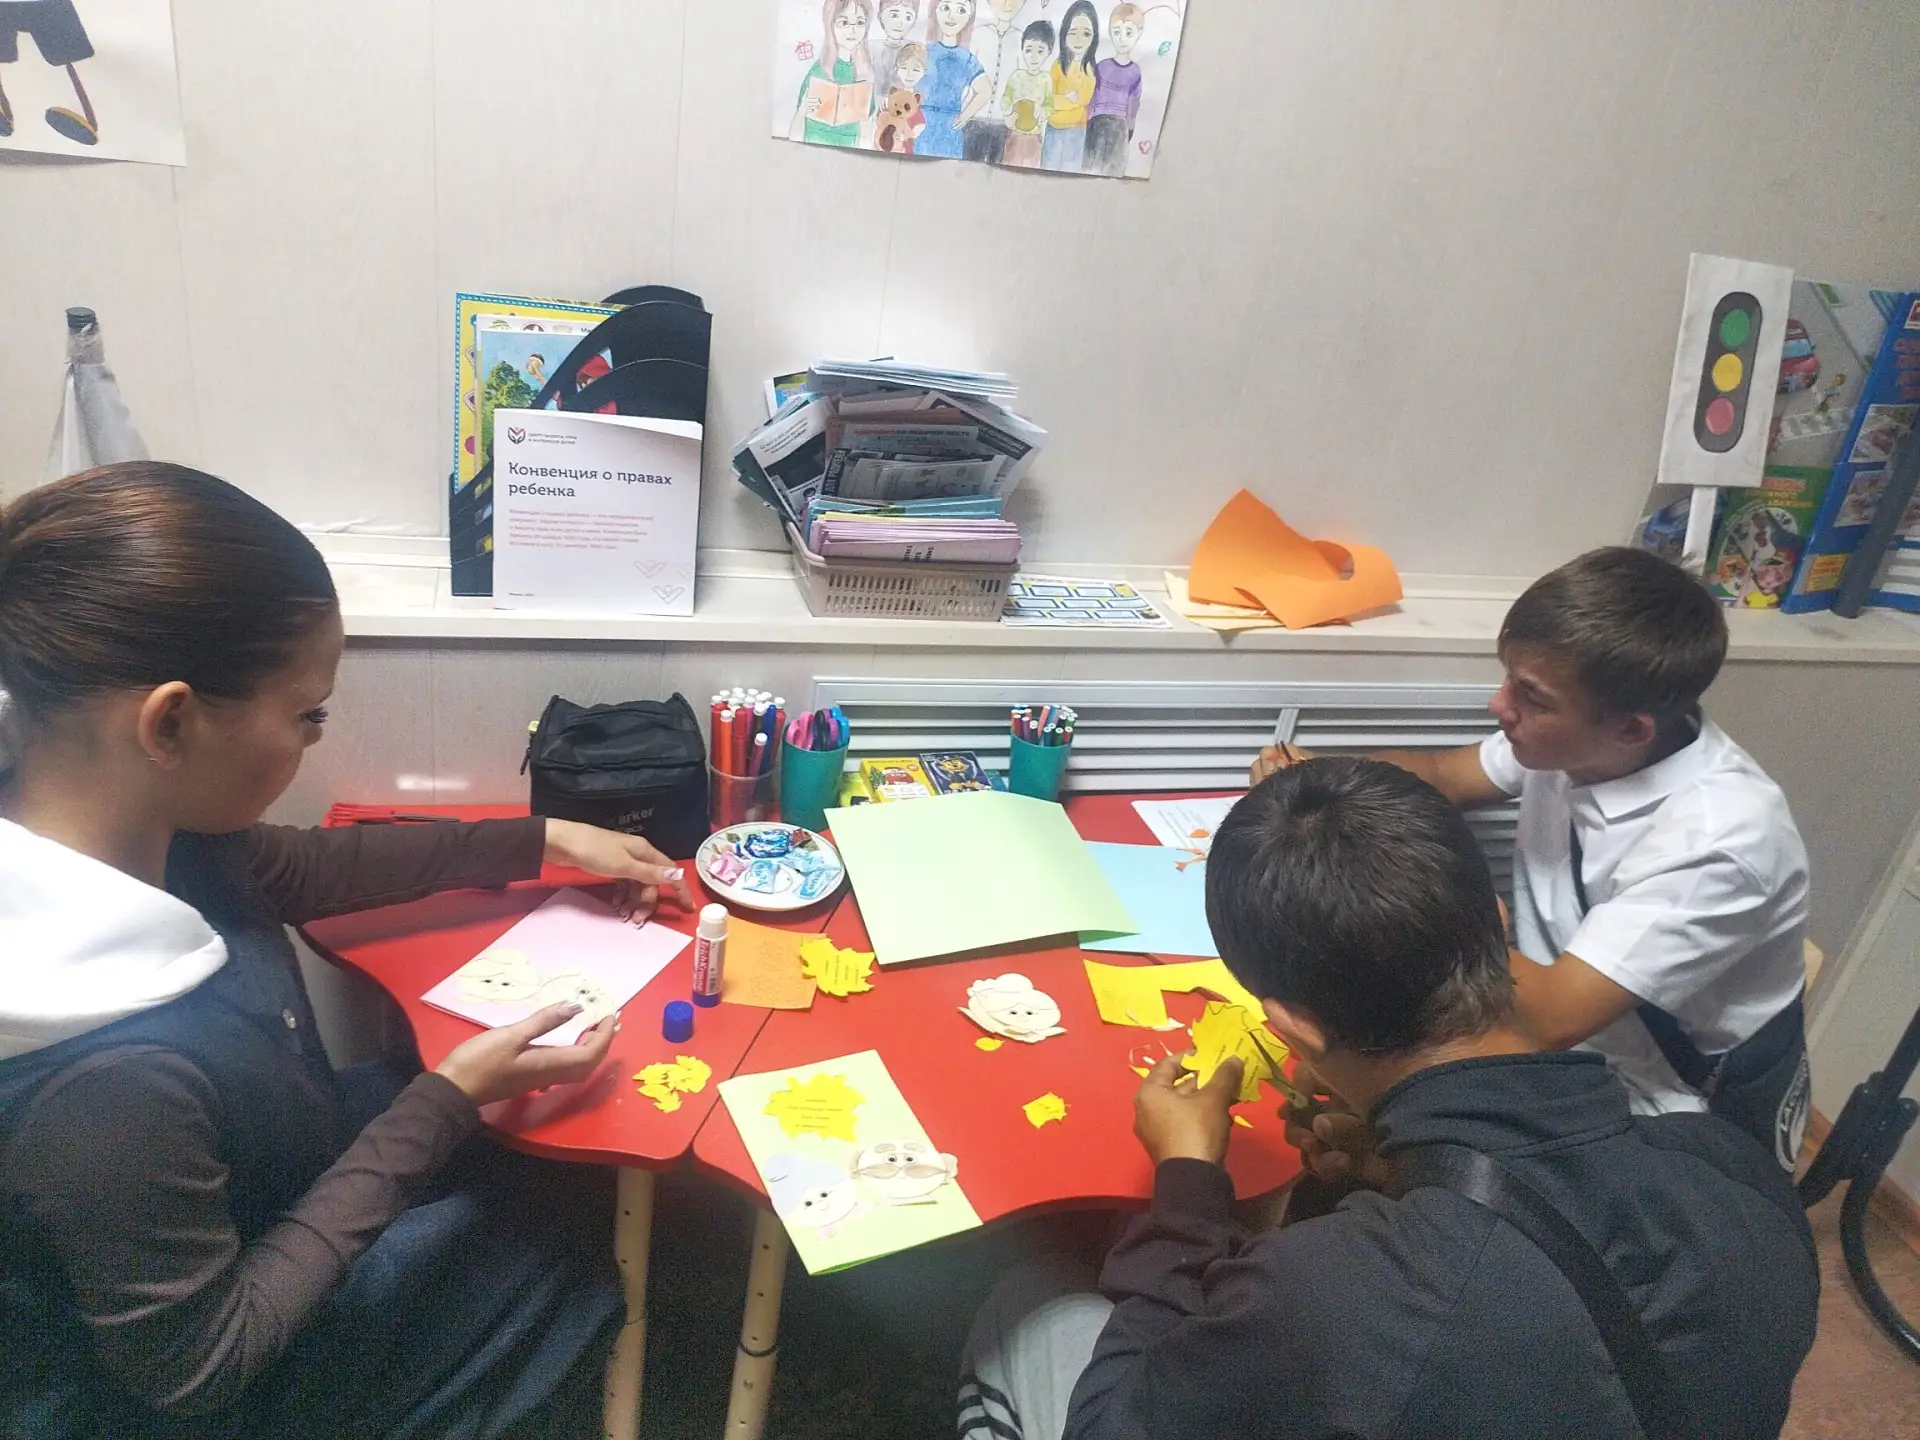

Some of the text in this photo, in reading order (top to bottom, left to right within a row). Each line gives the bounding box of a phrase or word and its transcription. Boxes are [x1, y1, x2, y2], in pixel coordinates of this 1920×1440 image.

[508, 461, 673, 486] Конвенция о правах
[508, 482, 576, 498] ребенка
